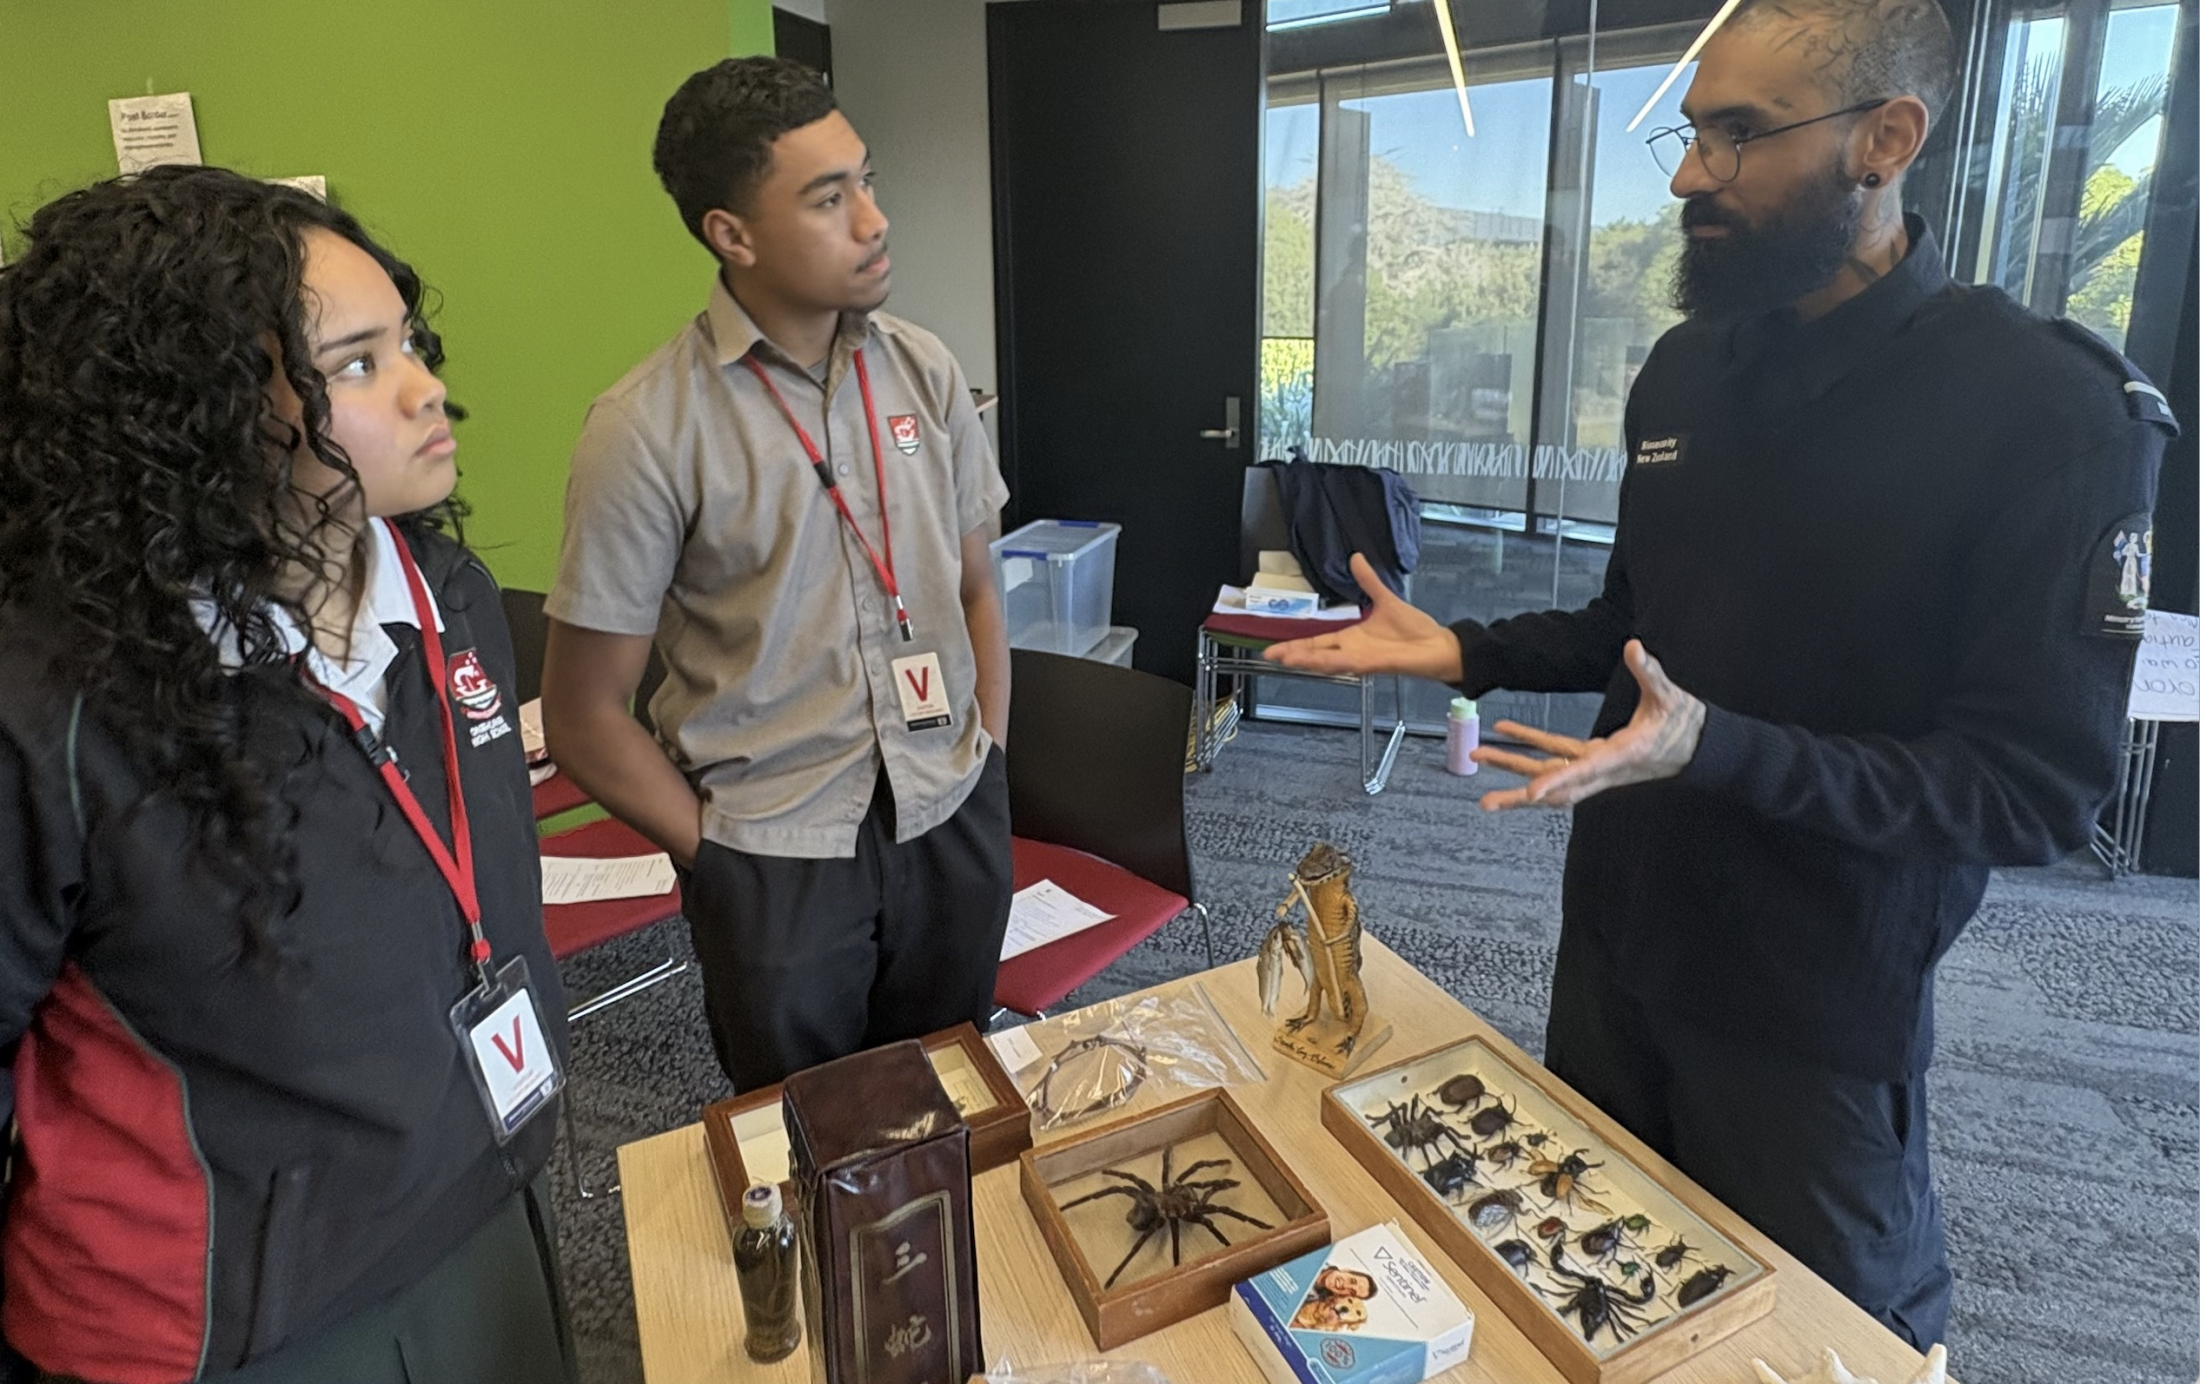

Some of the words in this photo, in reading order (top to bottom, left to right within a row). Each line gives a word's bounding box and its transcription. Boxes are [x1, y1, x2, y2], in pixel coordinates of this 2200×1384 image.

[905, 666, 929, 702] V
[491, 1013, 525, 1075] V
[1382, 1260, 1427, 1304] Sentinel
